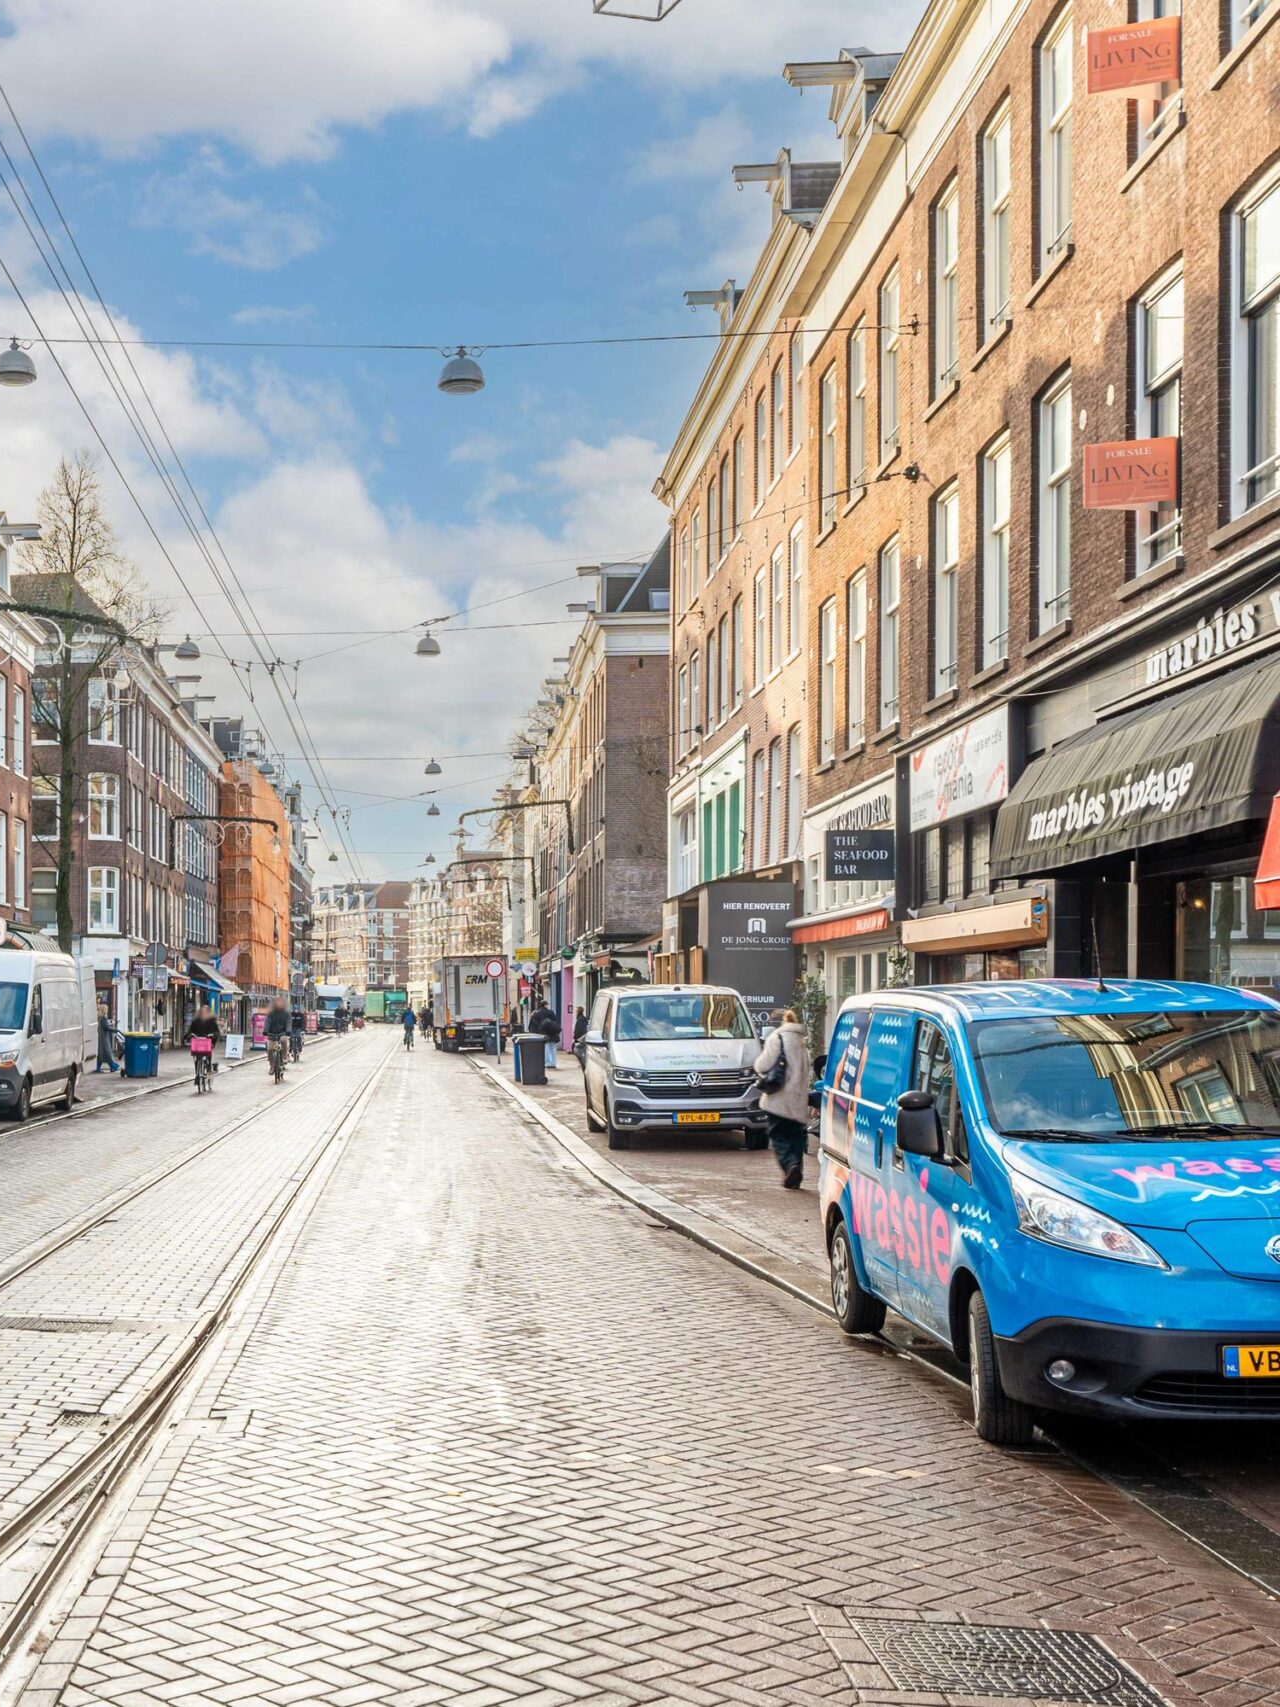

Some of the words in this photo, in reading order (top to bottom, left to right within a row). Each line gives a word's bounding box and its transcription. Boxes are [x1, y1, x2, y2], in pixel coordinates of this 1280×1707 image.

[1108, 32, 1129, 43] FOR
[1130, 29, 1153, 40] SALE
[1093, 42, 1171, 70] LIVING
[1105, 451, 1126, 459] FOR
[1127, 447, 1152, 457] SALE
[1091, 461, 1169, 484] LIVING
[1144, 603, 1255, 686] marbles
[943, 766, 973, 803] mania
[1028, 783, 1105, 842] marbles
[1110, 761, 1194, 820] vintage
[834, 836, 858, 846] THE
[834, 850, 889, 861] SEAFOOD
[835, 865, 858, 875] BAR
[723, 902, 742, 911] HIER
[743, 902, 791, 911] RENOVEERT
[721, 936, 734, 944] DE
[735, 936, 760, 945] JONG
[761, 936, 792, 944] GROEP
[741, 995, 775, 1003] ERHUUR
[850, 1167, 951, 1286] wassie
